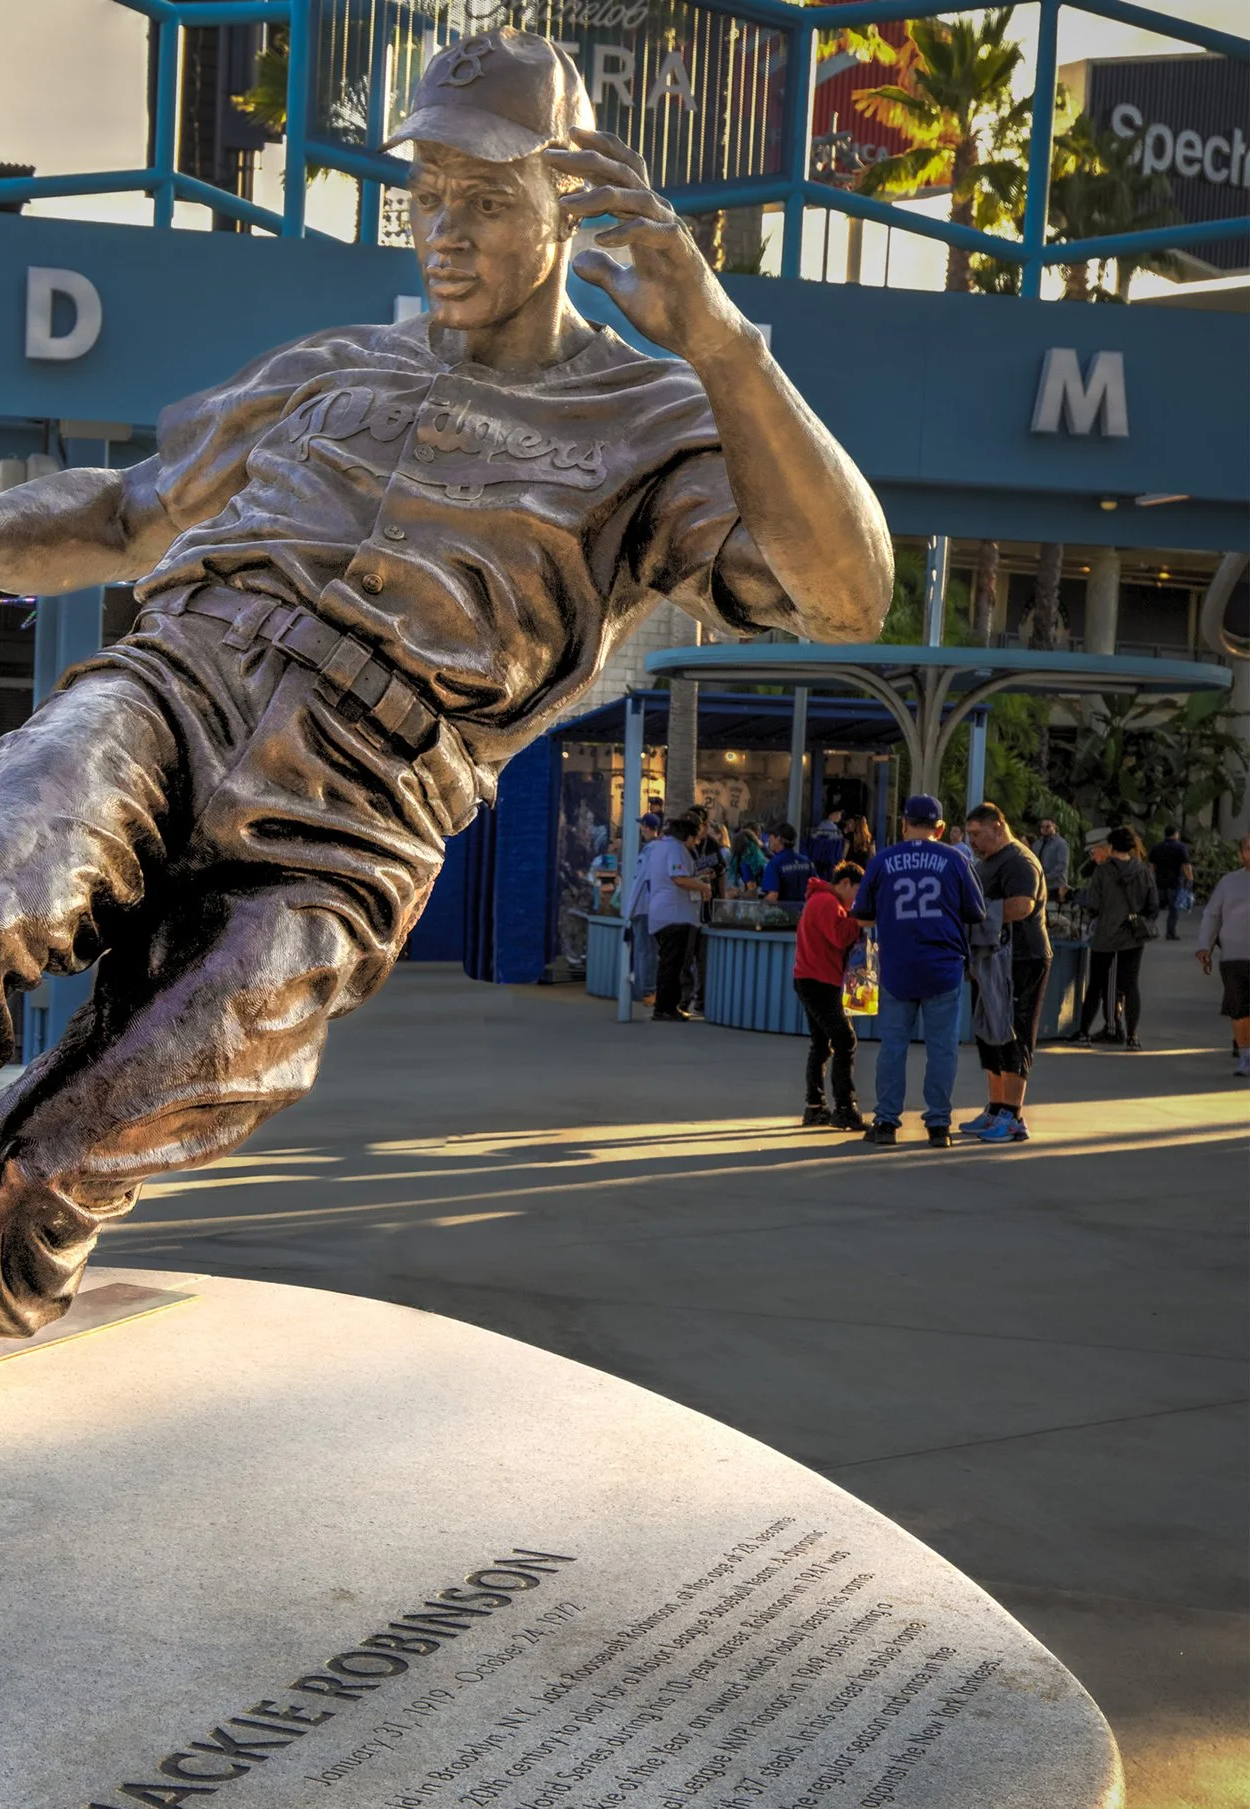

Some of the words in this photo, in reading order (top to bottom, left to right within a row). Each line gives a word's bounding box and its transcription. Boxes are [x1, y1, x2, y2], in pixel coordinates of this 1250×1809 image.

[289, 386, 608, 501] Dodgers
[885, 852, 948, 875] KERSHAW
[893, 876, 943, 920] 22
[721, 1551, 746, 1564] of
[768, 1556, 794, 1565] A
[705, 1562, 736, 1579] age
[674, 1589, 698, 1601] at
[680, 1576, 716, 1593] the
[698, 1584, 756, 1619] Baseball
[814, 1594, 851, 1609] his
[875, 1601, 895, 1611] a
[789, 1607, 836, 1631] bears
[836, 1609, 893, 1636] hitting
[657, 1618, 711, 1650] League
[764, 1630, 814, 1656] today
[880, 1621, 927, 1647] home
[820, 1635, 858, 1658] after
[866, 1646, 903, 1669] stole
[923, 1645, 959, 1663] the
[559, 1639, 632, 1683] Roosevelt
[624, 1649, 675, 1678] Major
[736, 1655, 782, 1682] which
[790, 1656, 834, 1680] 1949
[920, 1661, 945, 1674] in
[80, 1699, 337, 1809] ACKIE
[288, 1548, 578, 1701] ROBINSON
[554, 1747, 615, 1782] Series
[597, 1711, 664, 1747] during
[634, 1695, 678, 1714] his
[658, 1658, 720, 1695] 10-year
[739, 1593, 799, 1630] Robinson
[787, 1582, 811, 1595] in
[620, 1676, 643, 1686] a
[844, 1667, 882, 1683] he
[900, 1672, 934, 1696] once
[303, 1737, 396, 1788] January
[401, 1688, 456, 1717] 1919
[453, 1643, 527, 1683] October
[535, 1601, 585, 1626] 1972
[529, 1682, 577, 1705] Jack
[590, 1683, 630, 1702] for
[704, 1680, 751, 1714] award
[775, 1681, 810, 1694] in
[824, 1681, 867, 1713] career
[569, 1700, 616, 1726] play
[737, 1693, 798, 1729] honors
[879, 1693, 913, 1718] and
[925, 1696, 969, 1720] York
[548, 1723, 583, 1737] to
[685, 1713, 716, 1731] an
[795, 1712, 838, 1731] his
[902, 1719, 948, 1747] New
[710, 1726, 759, 1755] MVP
[784, 1729, 821, 1743] In
[845, 1717, 892, 1755] season
[504, 1736, 571, 1778] century
[625, 1756, 668, 1778] the
[887, 1745, 928, 1767] the
[613, 1774, 646, 1792] of
[666, 1754, 733, 1796] League
[730, 1774, 770, 1797] 37
[806, 1753, 857, 1796] regular
[403, 1781, 444, 1797] in
[457, 1778, 514, 1808] 20th
[859, 1765, 910, 1809] against
